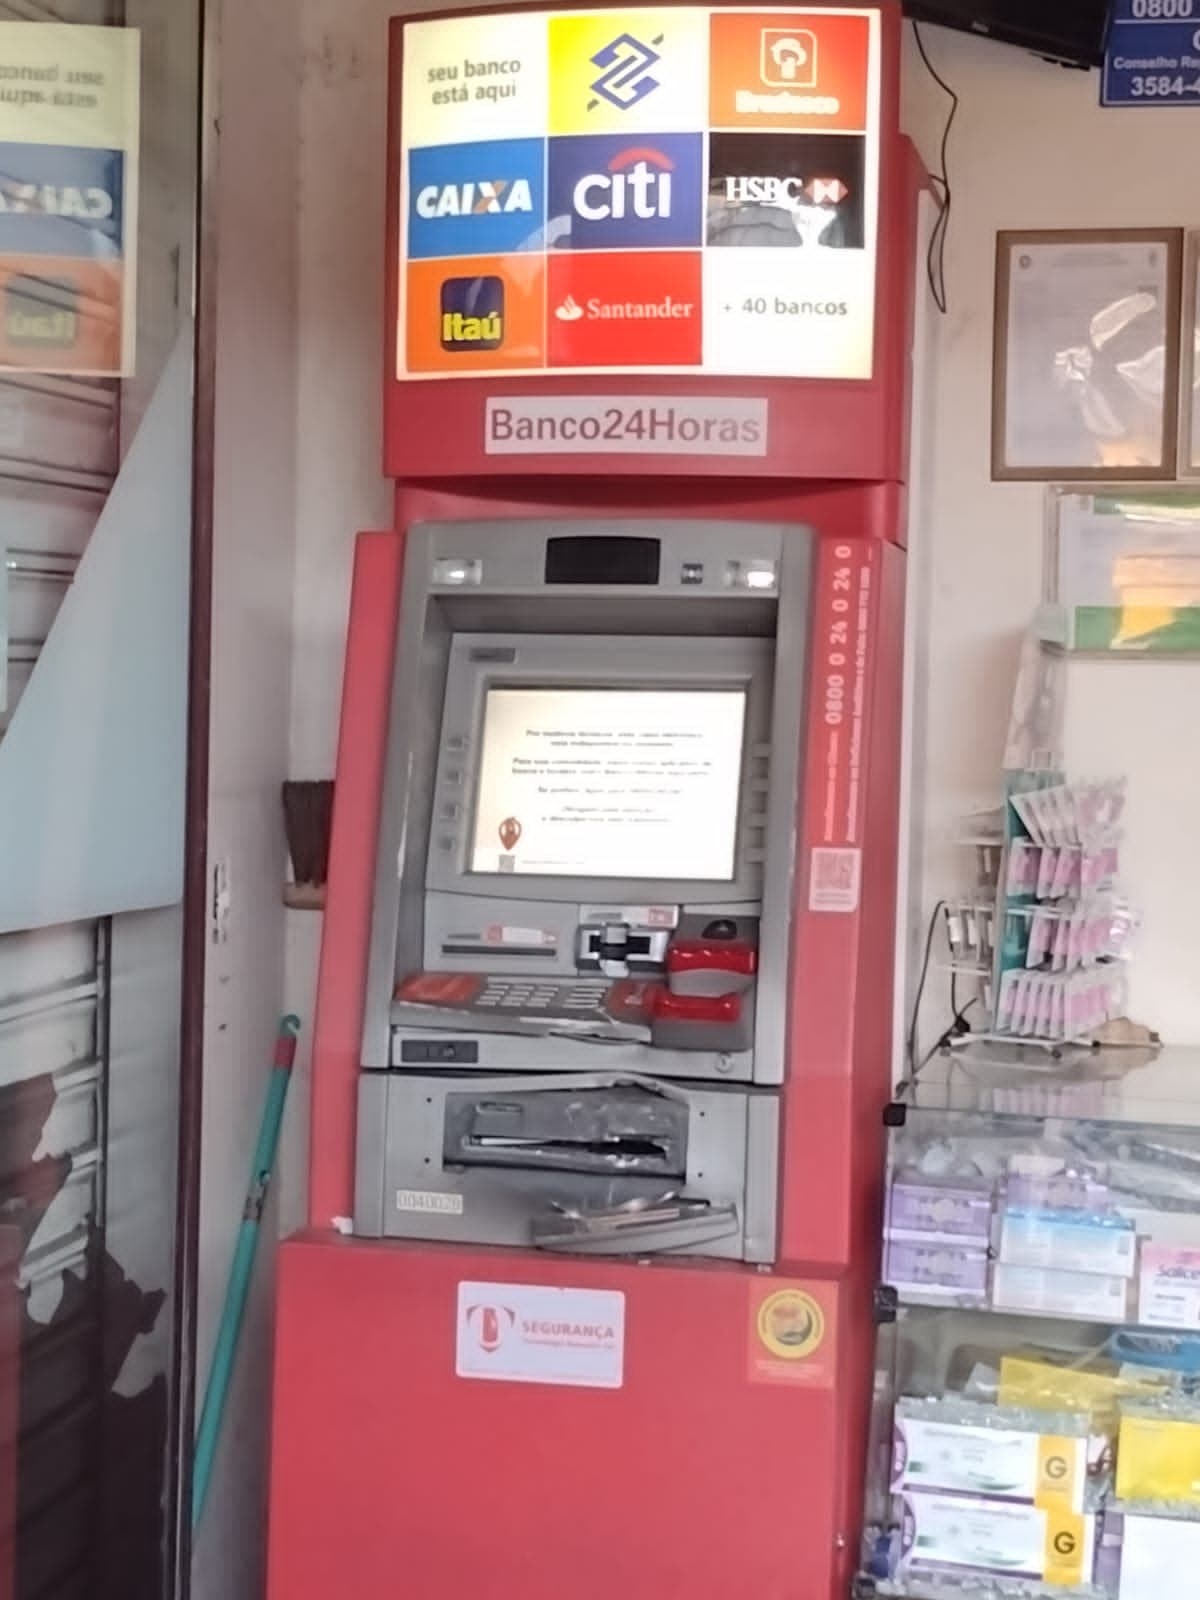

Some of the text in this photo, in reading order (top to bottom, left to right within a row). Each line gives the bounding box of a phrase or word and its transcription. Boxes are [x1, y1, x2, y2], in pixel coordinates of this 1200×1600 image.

[1131, 0, 1193, 18] 0800
[427, 59, 521, 83] seu banco
[1113, 56, 1178, 69] Conselho
[431, 80, 516, 104] está aqui
[416, 179, 534, 219] CAIXA
[573, 161, 672, 221] citi
[725, 176, 803, 202] HSBC
[586, 296, 694, 320] Santander
[742, 298, 767, 315] 40
[774, 297, 848, 316] bancos
[442, 311, 501, 342] Itaú
[491, 408, 760, 443] Banco24Horas
[835, 545, 852, 559] 0
[833, 567, 850, 591] 24
[832, 599, 848, 612] 0
[830, 620, 848, 645] 24
[828, 653, 846, 666] 0
[825, 674, 844, 725] 0800
[522, 1320, 615, 1340] SEGURANÇA
[1044, 1456, 1068, 1479] G
[1053, 1531, 1076, 1554] G
